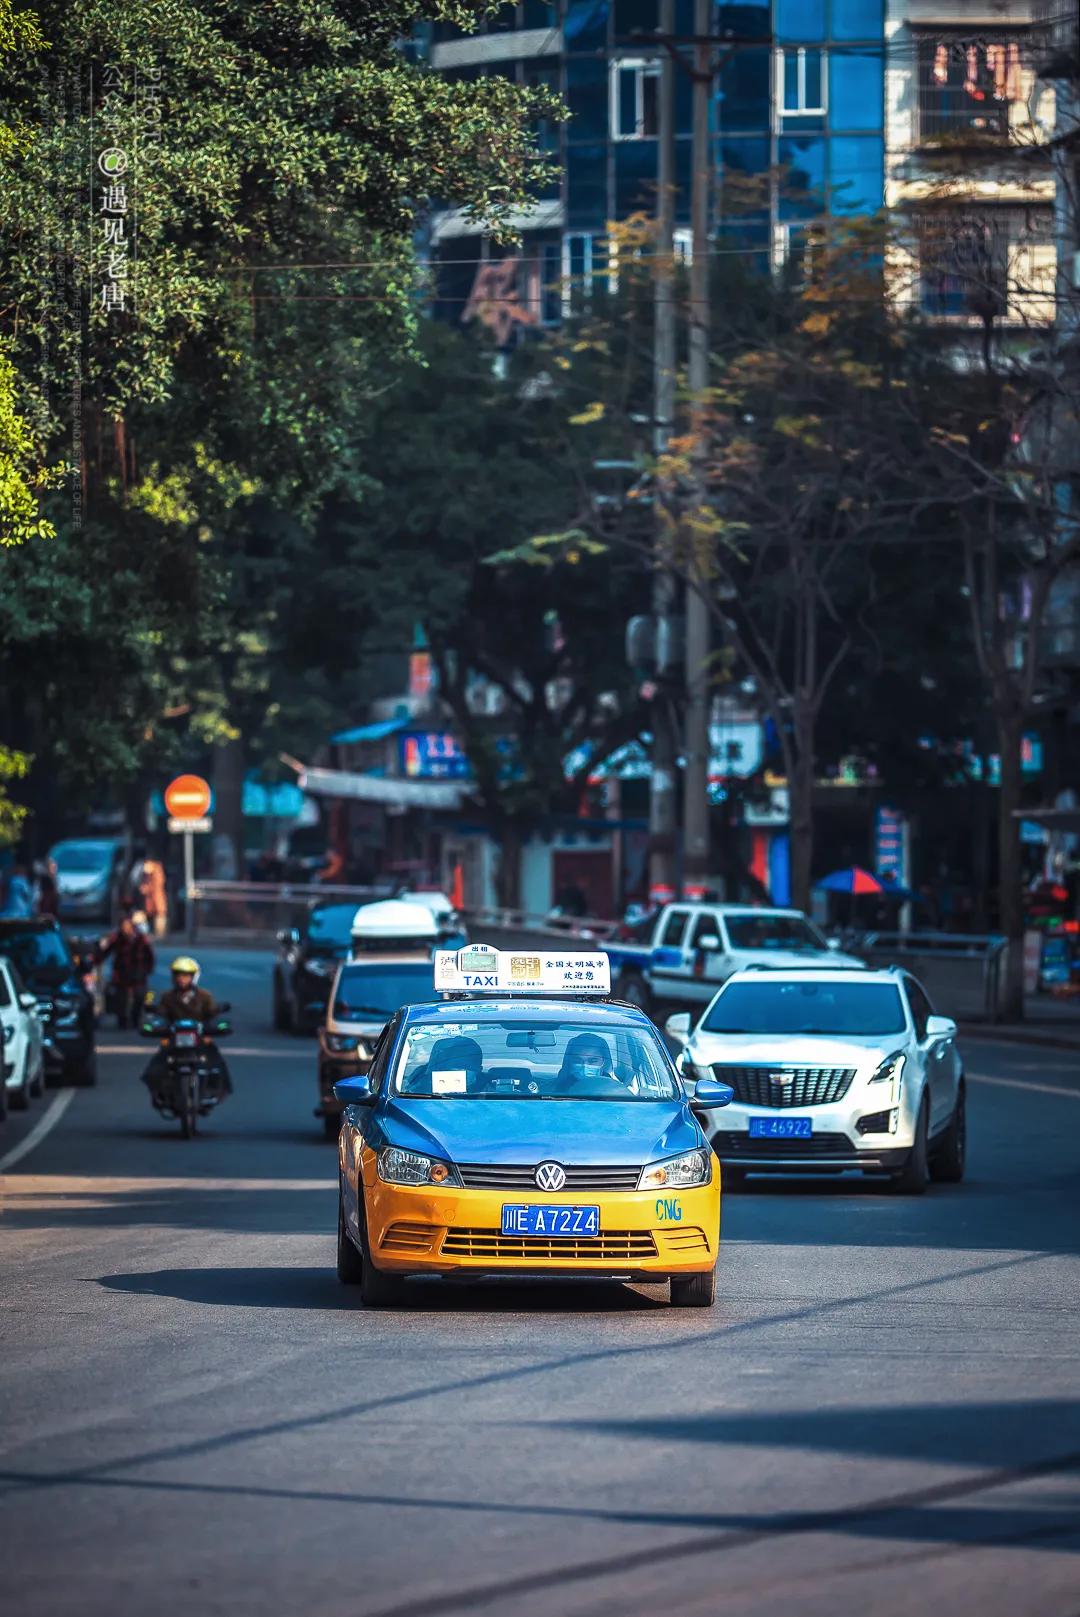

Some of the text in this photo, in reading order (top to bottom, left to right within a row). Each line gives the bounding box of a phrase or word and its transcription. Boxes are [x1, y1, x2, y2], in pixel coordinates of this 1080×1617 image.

[545, 960, 605, 968] 全国文明城市
[463, 976, 499, 986] TAXI
[563, 971, 594, 981] 欢迎您
[656, 1198, 682, 1221] CNG
